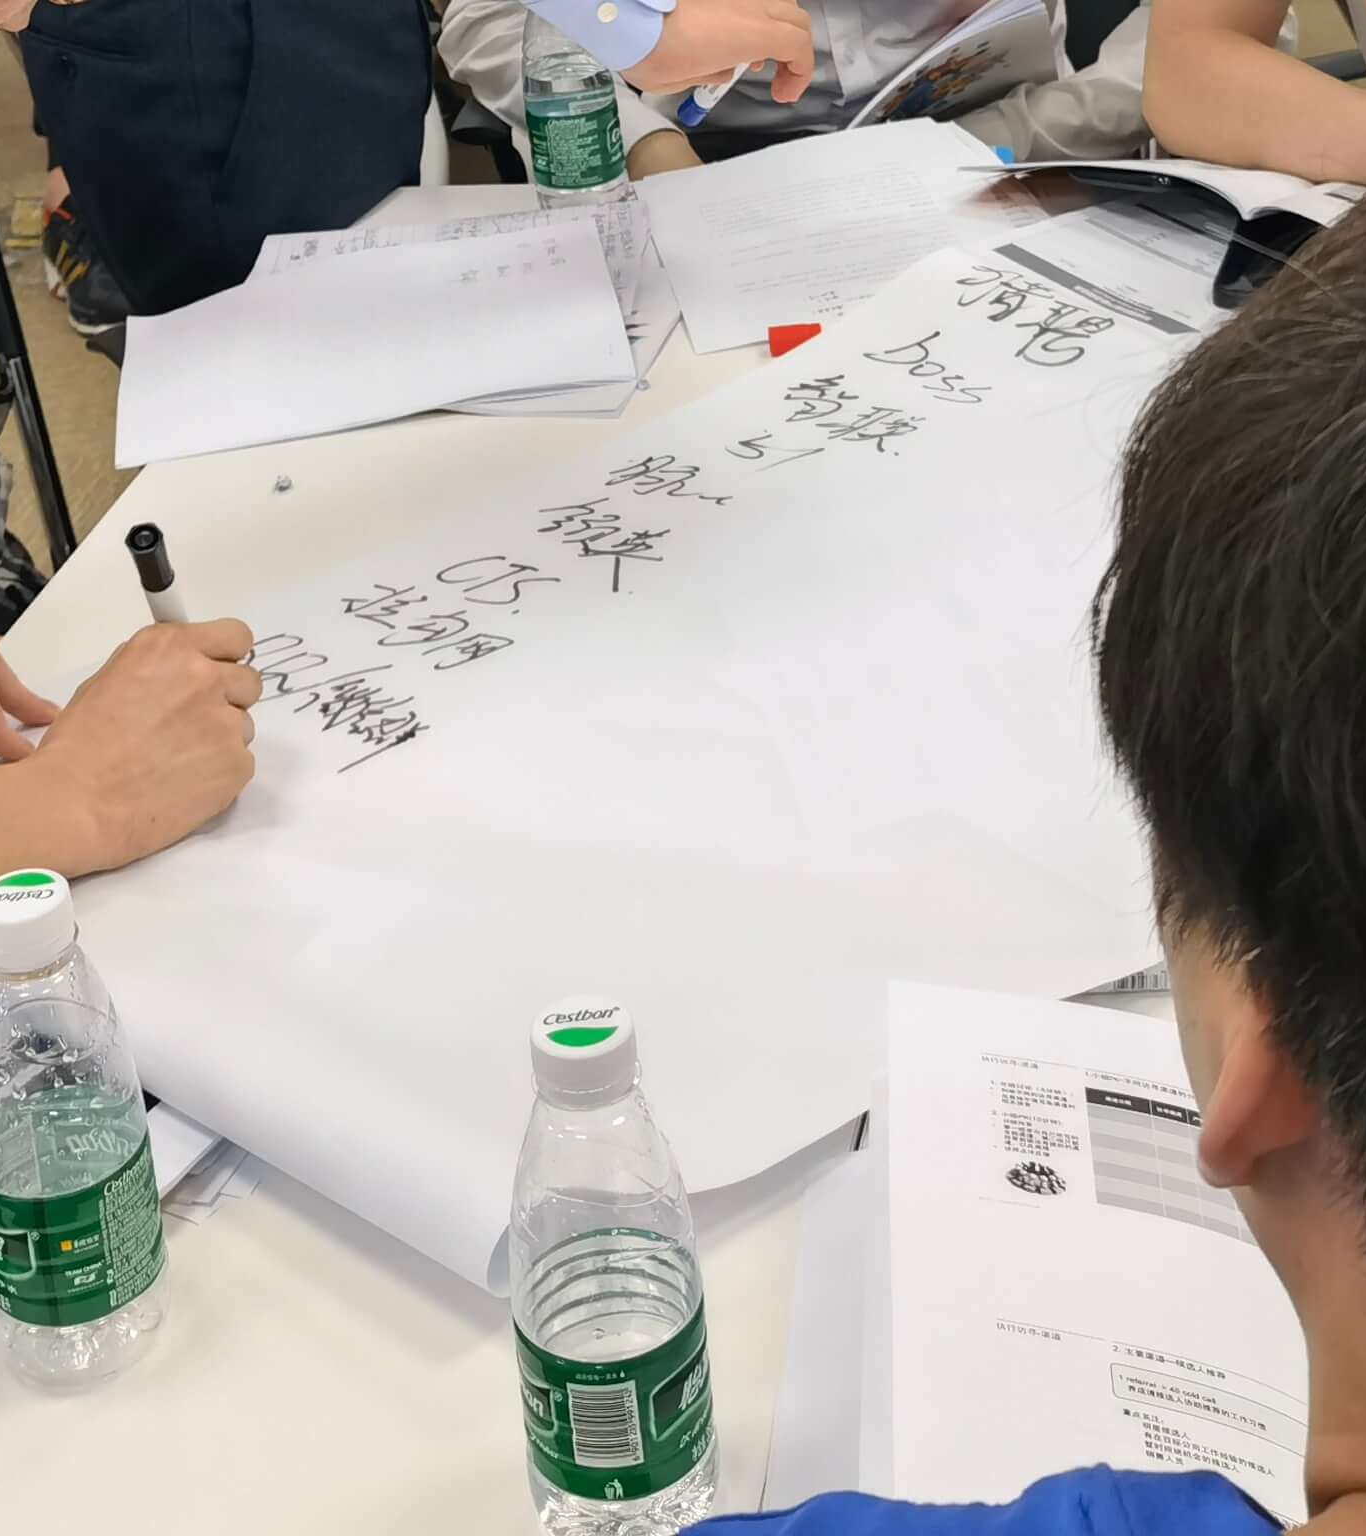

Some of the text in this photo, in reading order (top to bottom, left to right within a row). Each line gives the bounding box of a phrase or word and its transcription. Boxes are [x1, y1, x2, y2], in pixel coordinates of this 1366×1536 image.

[863, 331, 993, 405] boss
[1126, 1376, 1157, 1388] referral
[1182, 1390, 1200, 1400] cold
[1202, 1395, 1216, 1404] call
